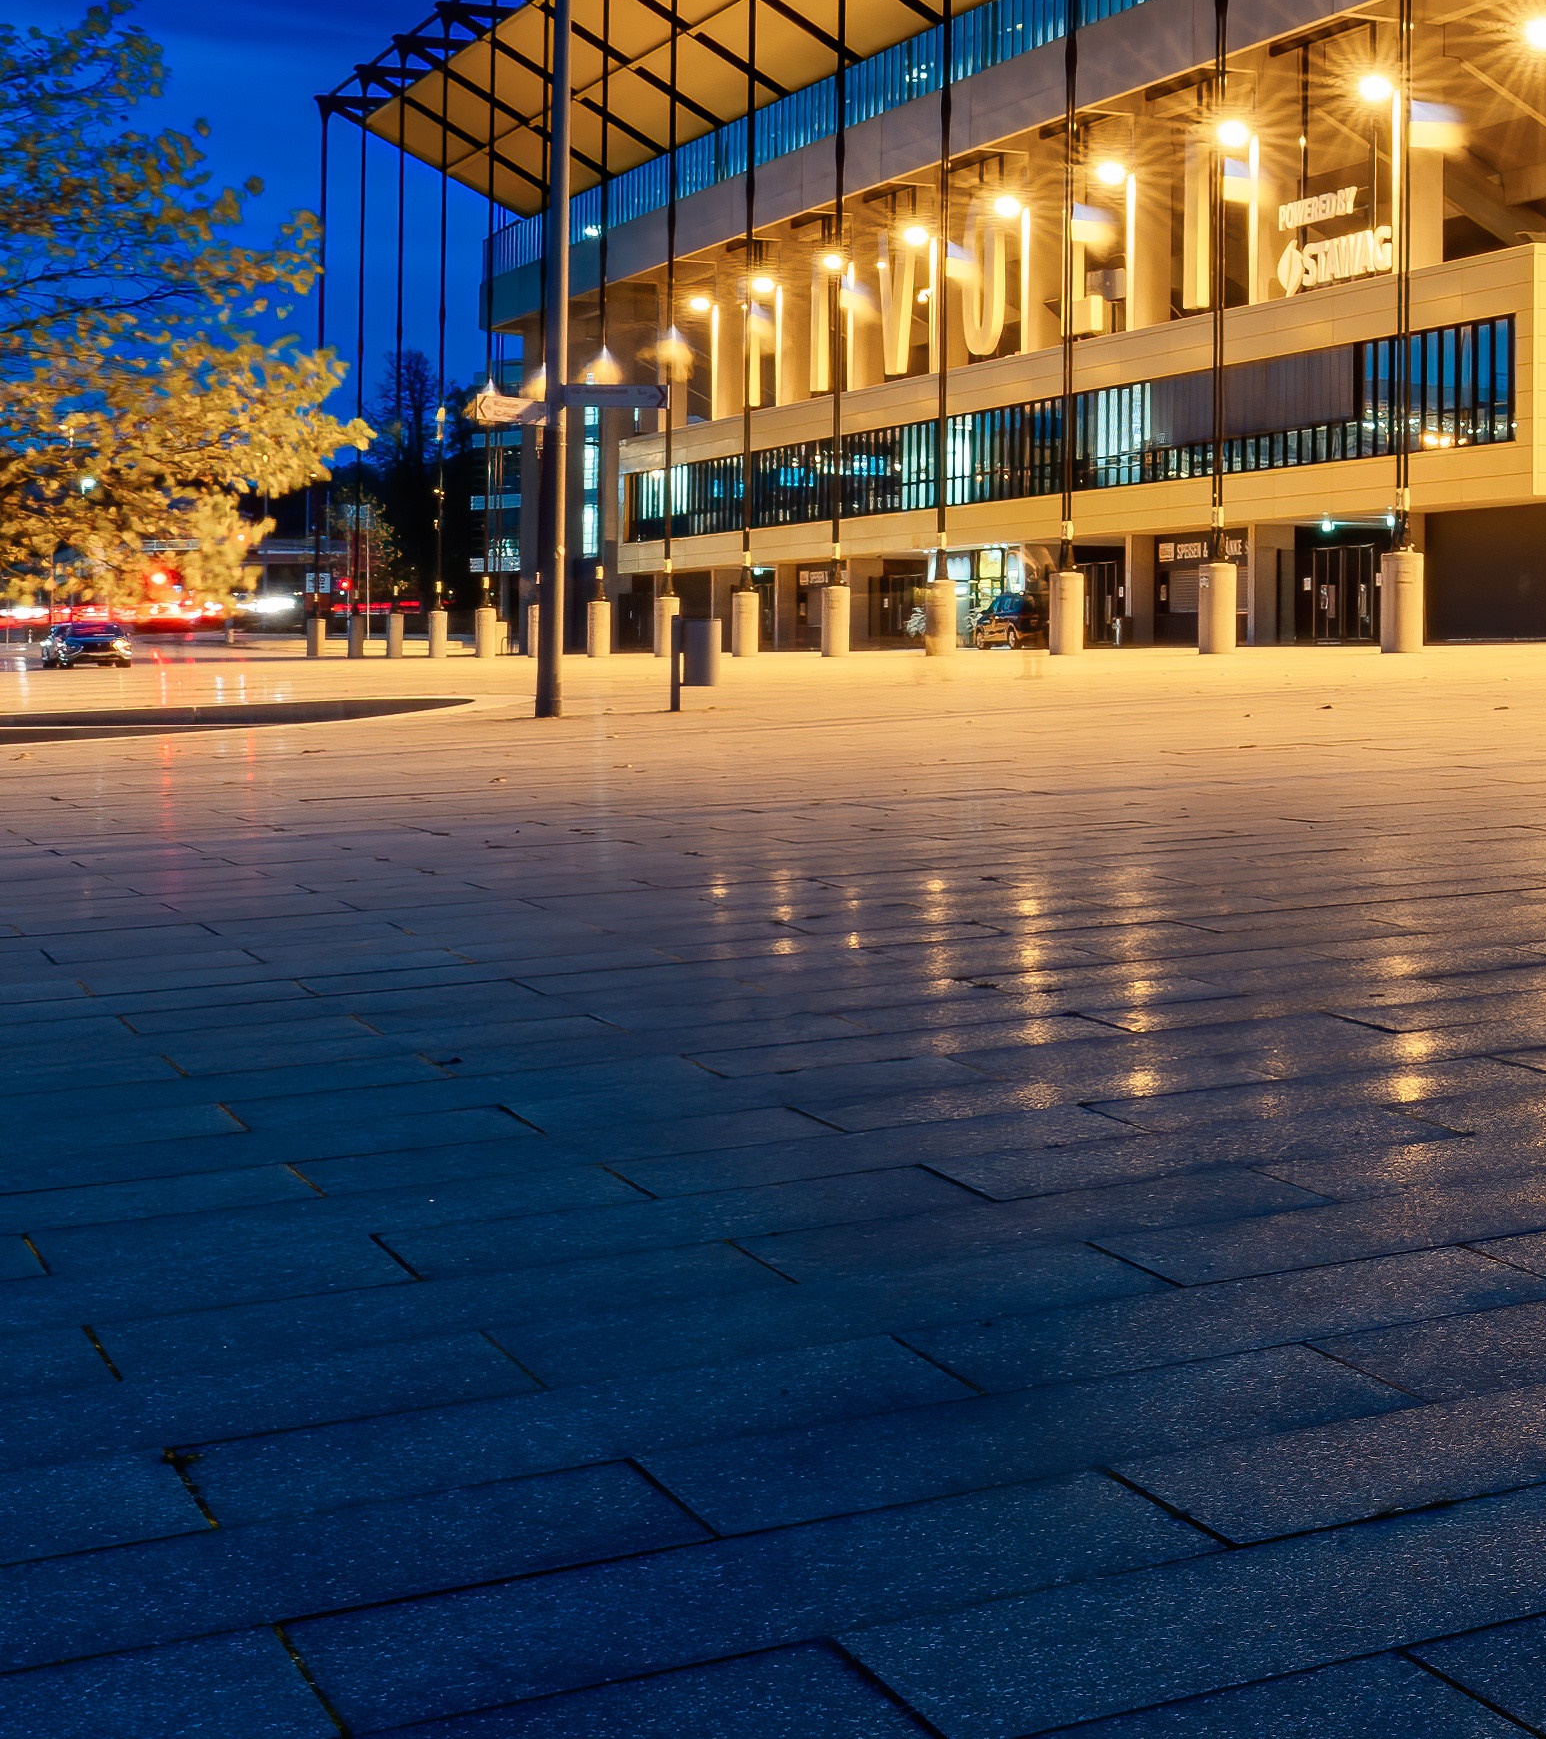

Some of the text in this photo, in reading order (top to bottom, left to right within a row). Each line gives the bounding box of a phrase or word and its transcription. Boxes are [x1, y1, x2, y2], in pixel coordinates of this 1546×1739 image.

[1278, 185, 1357, 231] POWERED BY
[1301, 225, 1393, 287] STAWAG
